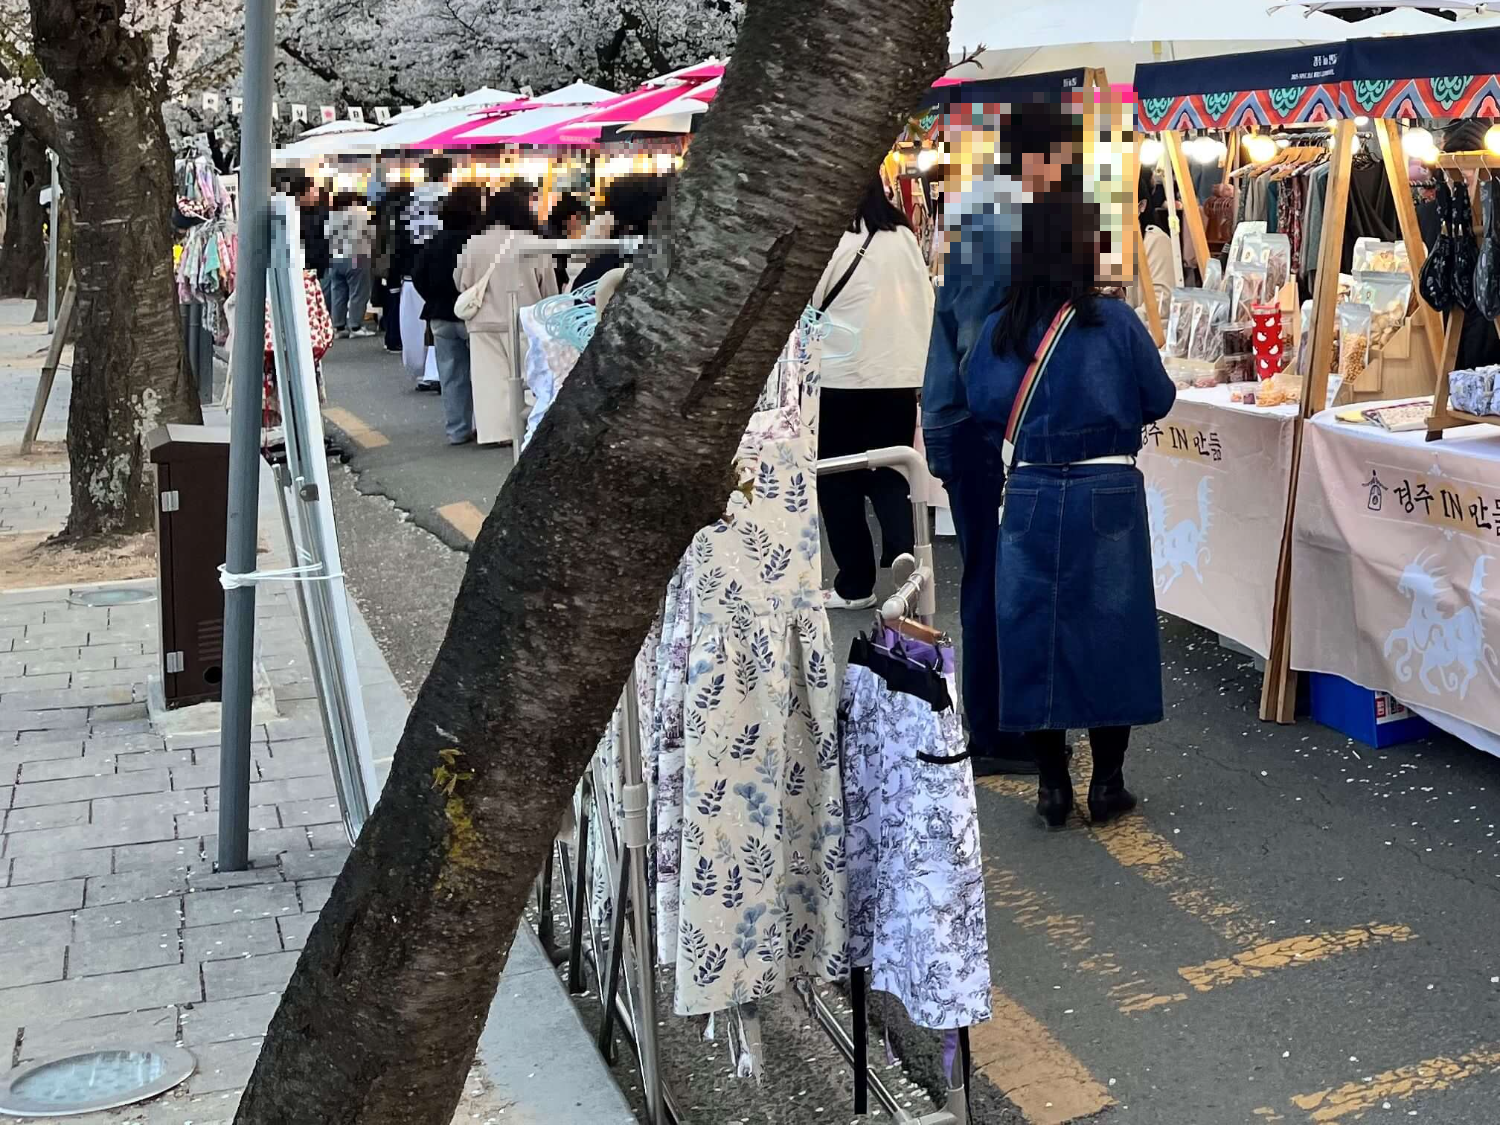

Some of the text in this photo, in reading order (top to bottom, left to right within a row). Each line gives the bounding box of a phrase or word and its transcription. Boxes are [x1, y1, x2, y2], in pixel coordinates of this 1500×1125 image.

[1169, 426, 1189, 451] IN
[1393, 479, 1435, 516] 경주
[1440, 489, 1464, 522] IN
